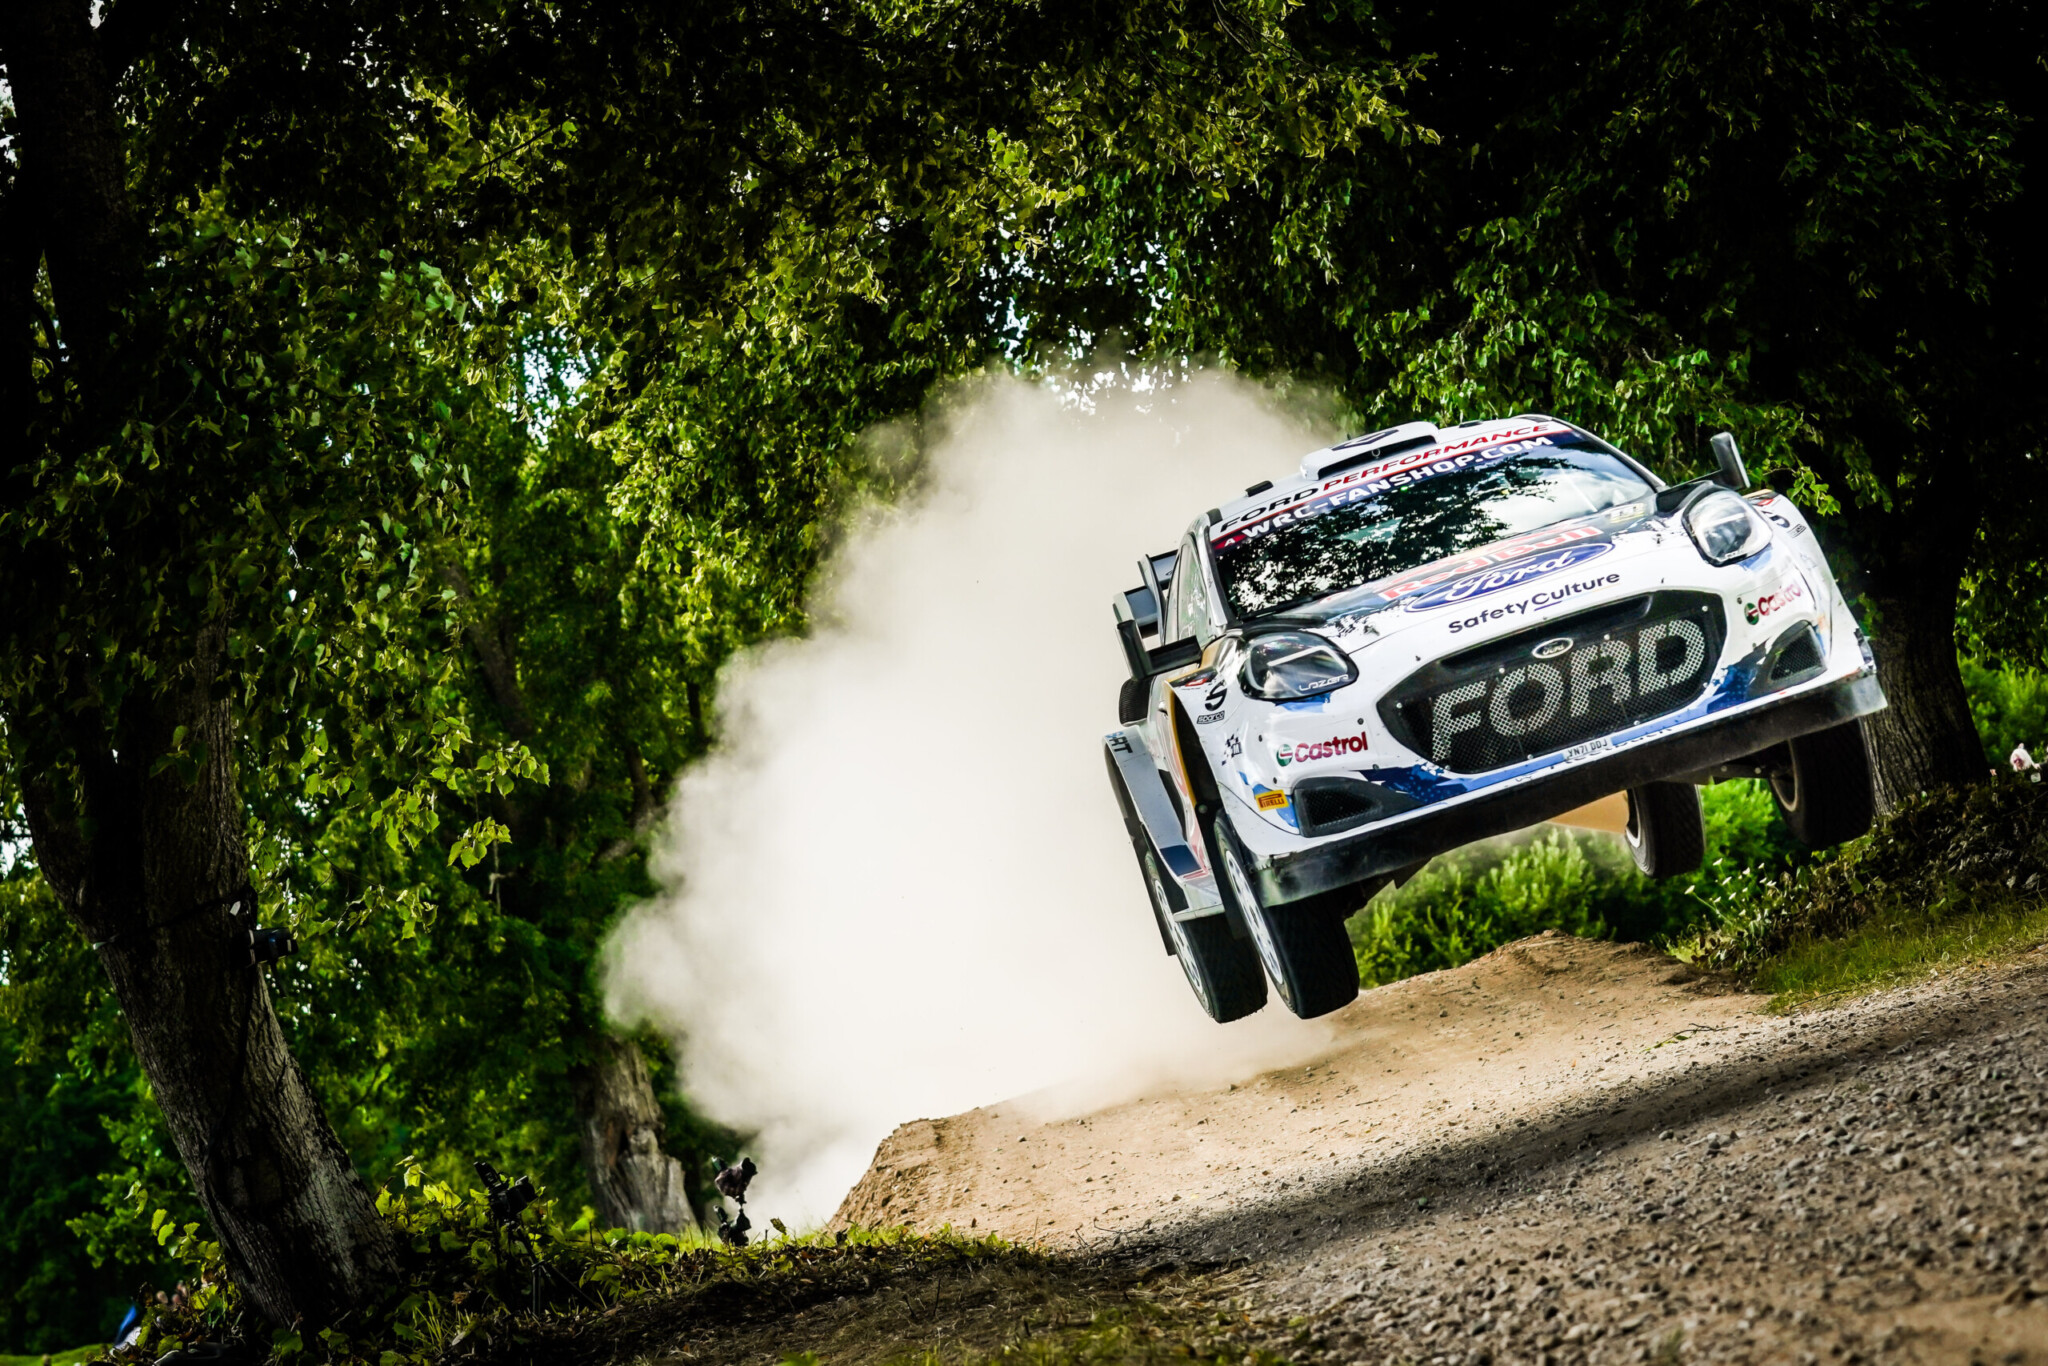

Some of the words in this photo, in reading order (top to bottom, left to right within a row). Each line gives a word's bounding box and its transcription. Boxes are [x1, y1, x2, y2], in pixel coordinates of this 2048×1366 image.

[1241, 436, 1553, 537] WRC-FANSHOP.COM
[1445, 549, 1577, 600] Ford
[1448, 572, 1620, 634] SafetyCulture
[1432, 619, 1705, 763] FORD
[1295, 731, 1369, 763] Castrol
[1258, 793, 1286, 808] PIRELLI
